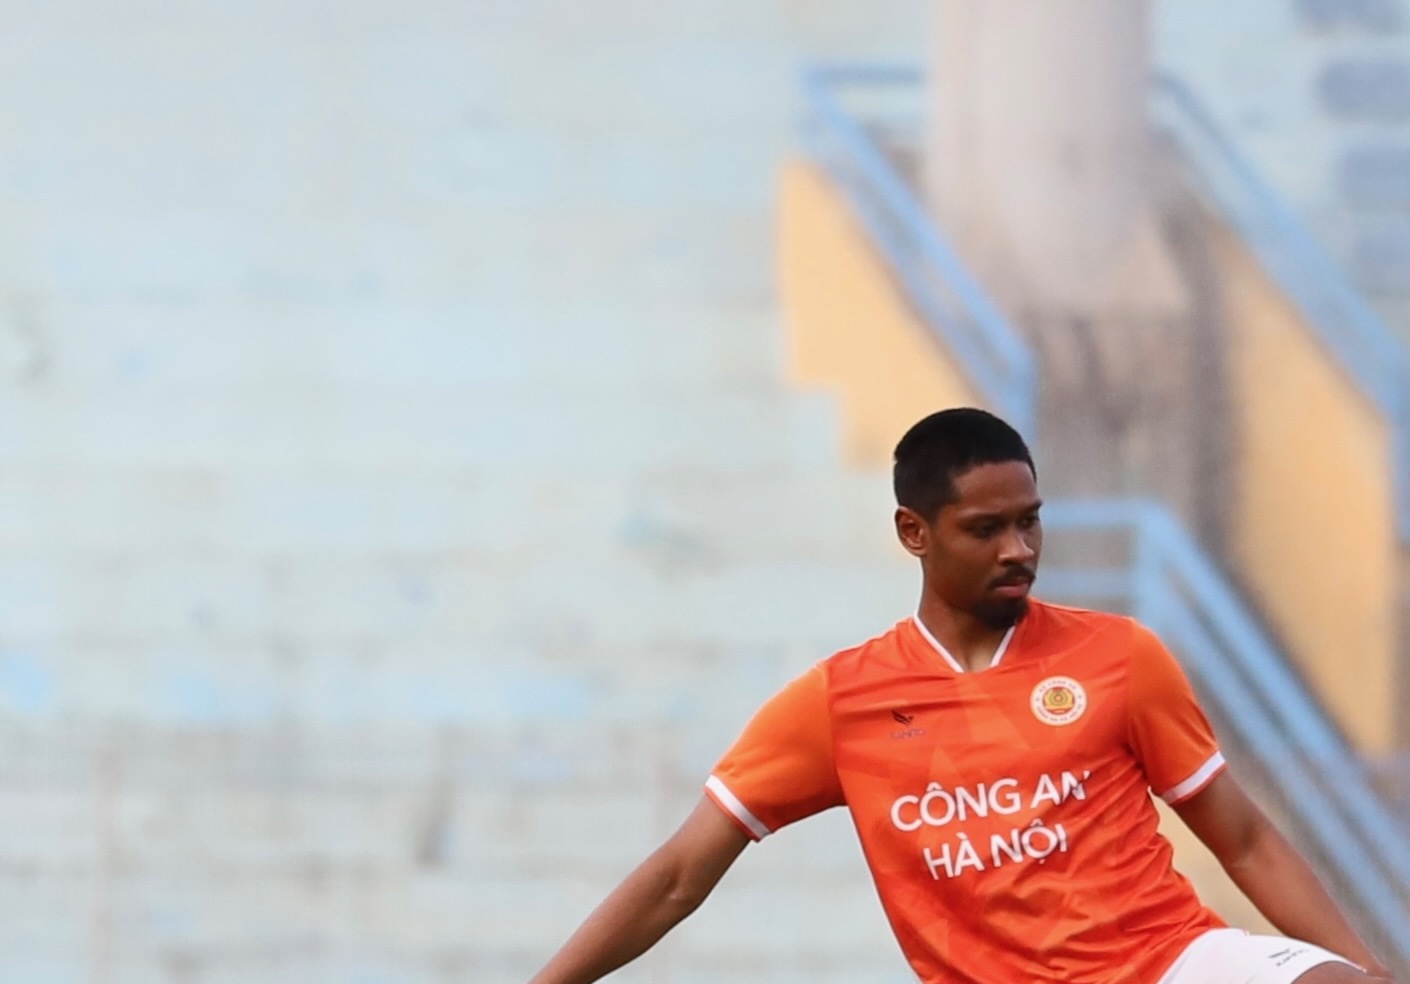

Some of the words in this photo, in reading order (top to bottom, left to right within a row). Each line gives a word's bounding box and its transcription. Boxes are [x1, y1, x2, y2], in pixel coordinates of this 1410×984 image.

[890, 778, 1022, 831] CÔNG
[1030, 770, 1091, 809] AN
[923, 832, 985, 880] HÀ
[990, 818, 1067, 868] NỘI
